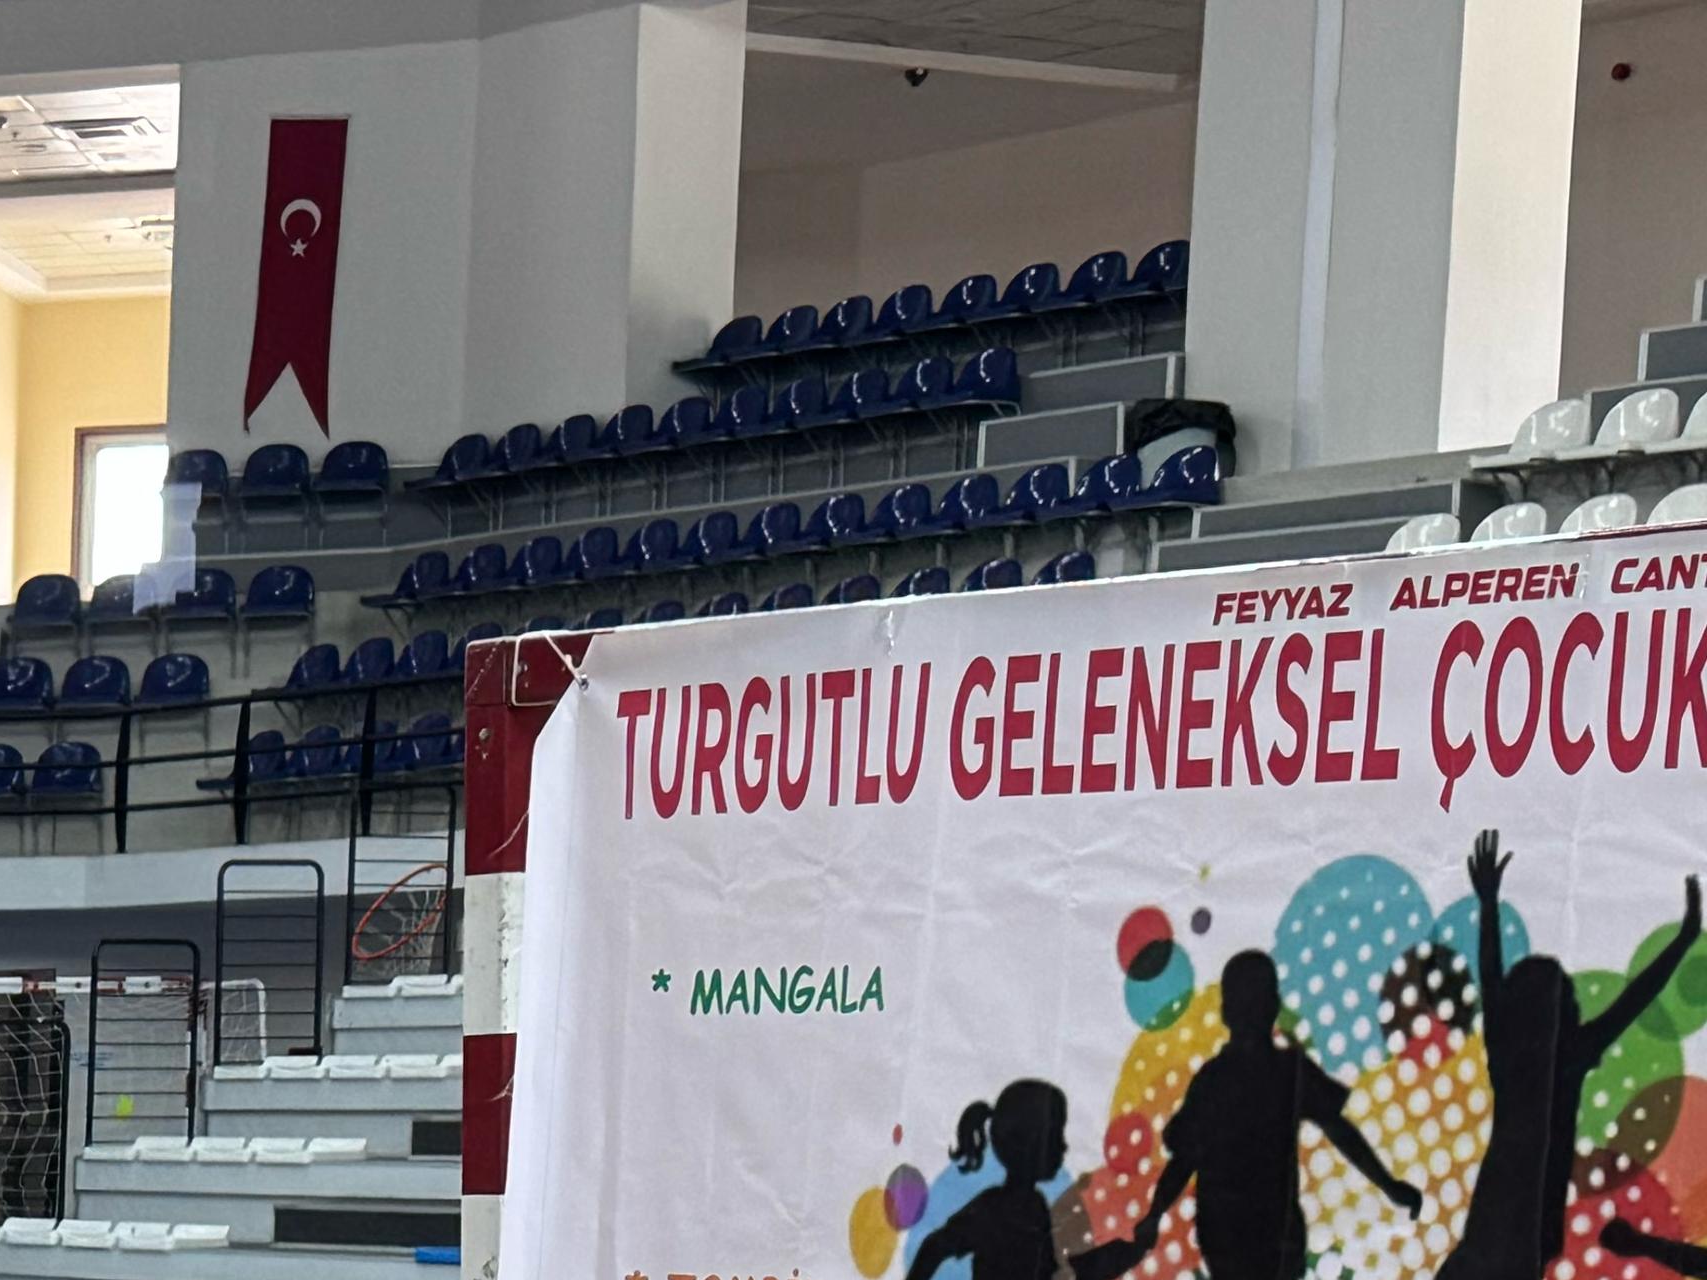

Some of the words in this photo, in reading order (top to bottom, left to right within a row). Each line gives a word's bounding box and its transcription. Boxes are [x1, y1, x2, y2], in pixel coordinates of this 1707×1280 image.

[1212, 583, 1354, 626] FEYYAZ
[1389, 562, 1581, 611] ALPEREN
[617, 662, 934, 821] TURGUTLU
[949, 627, 1400, 802] GELENEKSEL
[1430, 608, 1707, 813] ÇOCUK
[690, 966, 885, 1017] MANGALA
